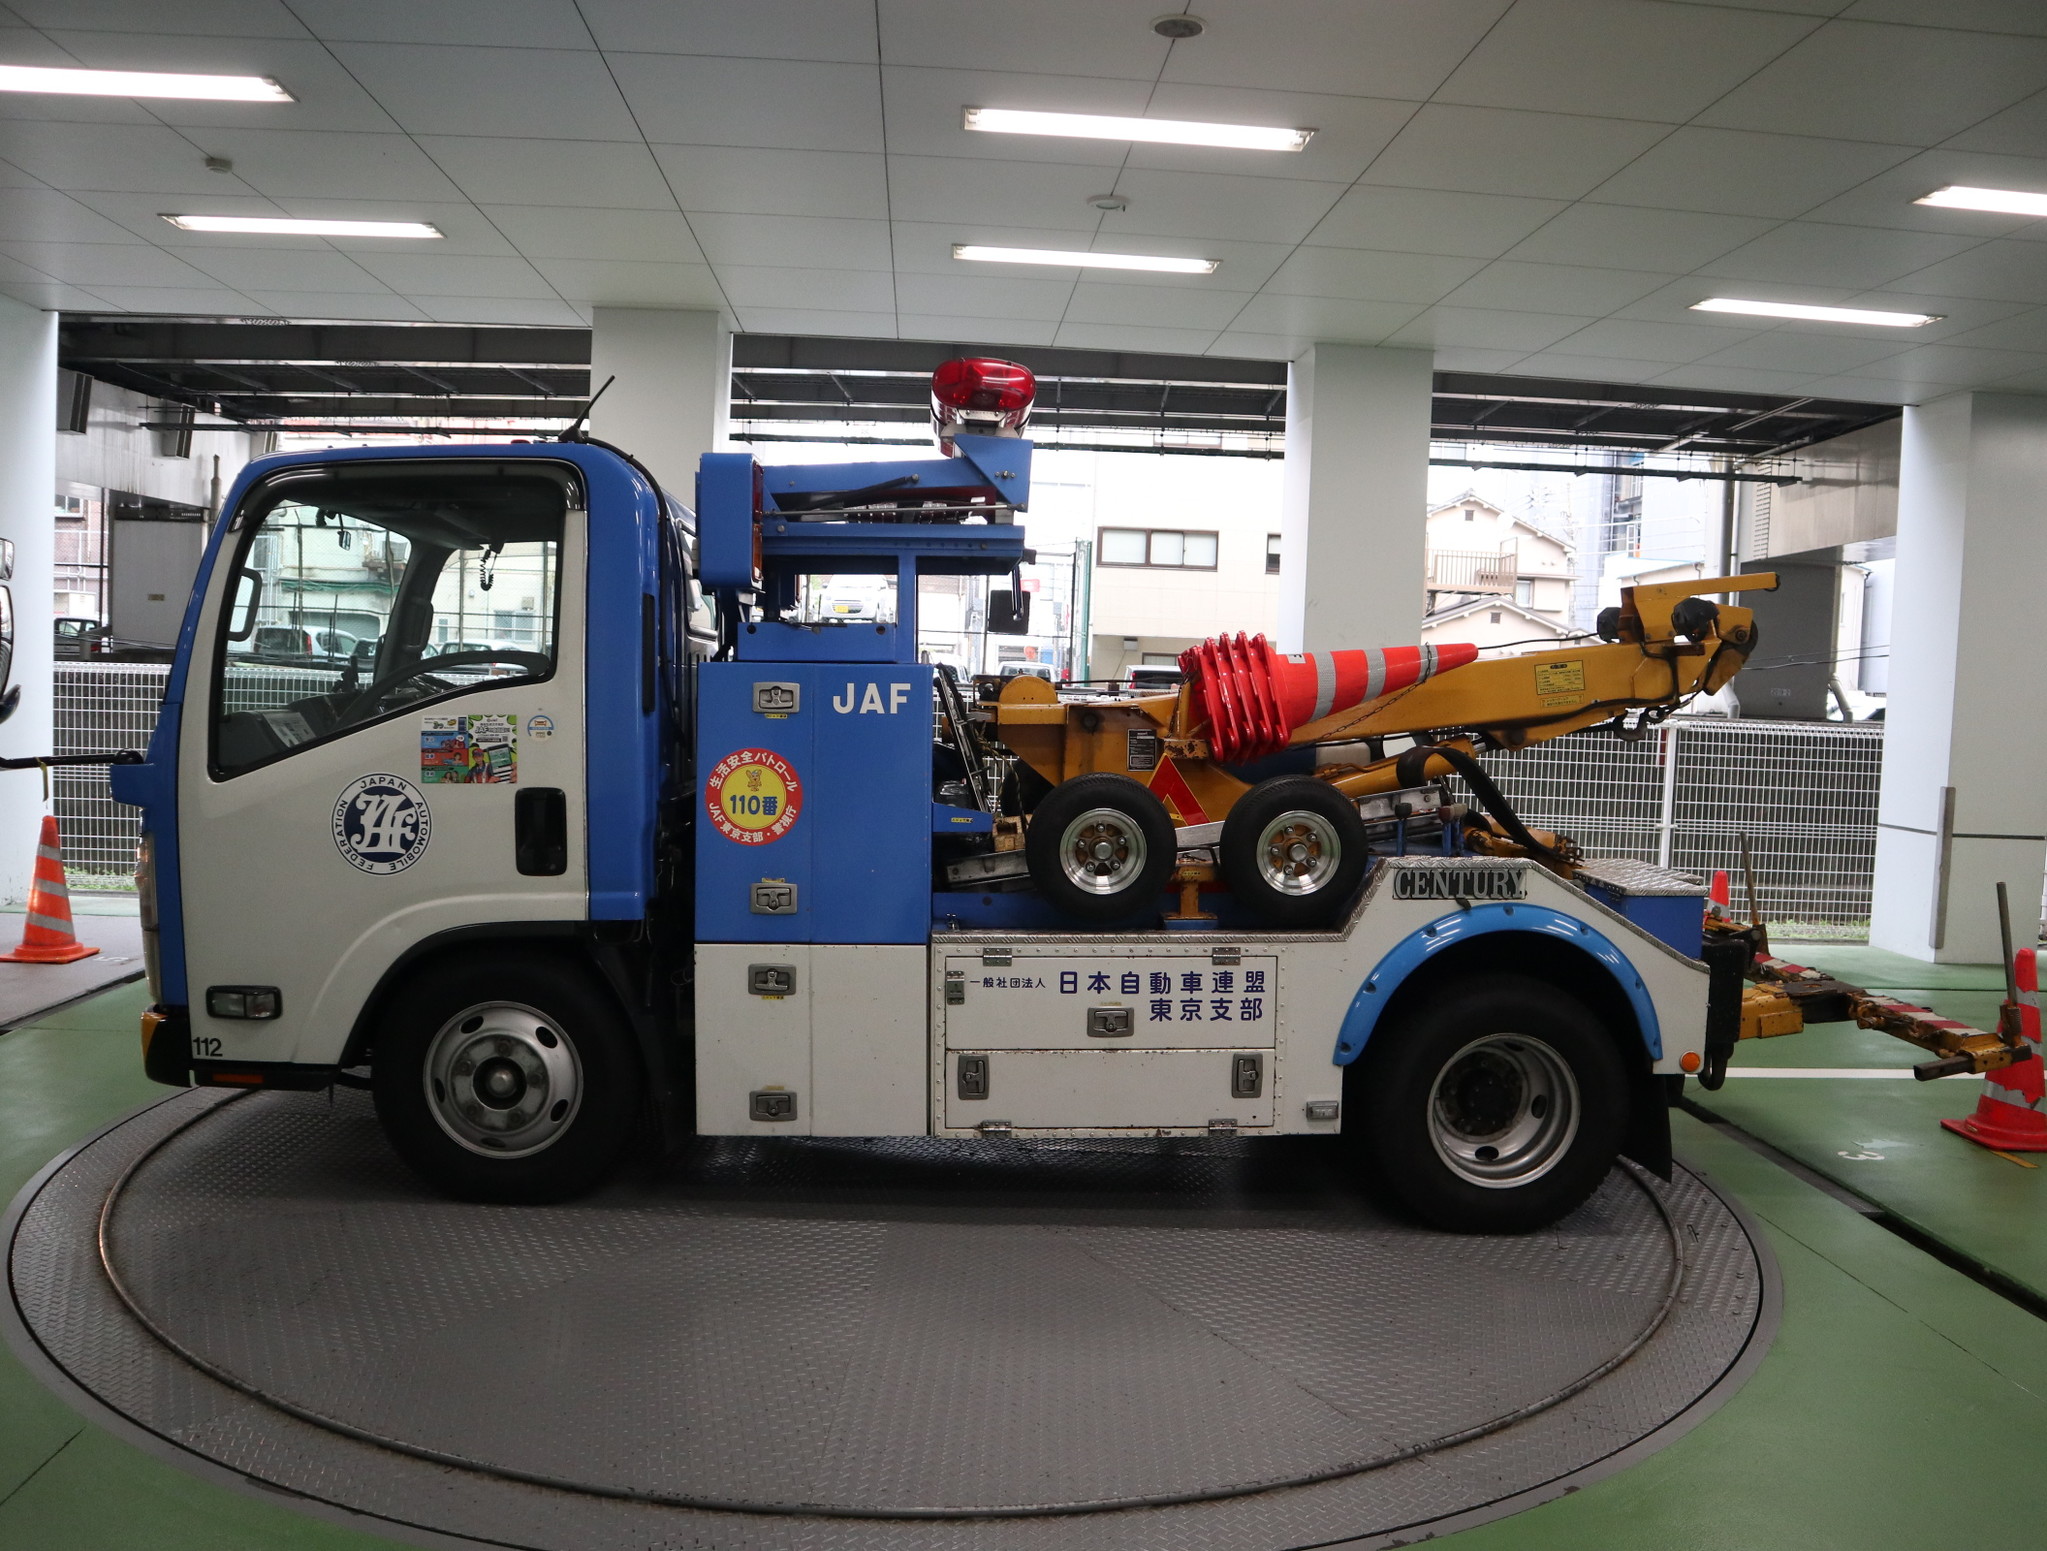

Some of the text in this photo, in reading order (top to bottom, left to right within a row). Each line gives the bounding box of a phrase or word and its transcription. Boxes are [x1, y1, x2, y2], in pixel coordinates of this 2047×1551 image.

[832, 682, 912, 715] JAF
[708, 750, 799, 793] 生活安全パトロール
[729, 794, 778, 817] 110番
[333, 777, 429, 872] JAPAN AUTOMOBILE FEDERATION
[1394, 868, 1527, 900] CENTURY
[969, 970, 1267, 995] 一般社団法人 日本自動車連盟
[1149, 997, 1265, 1023] 東京支部
[192, 1036, 223, 1057] 112
